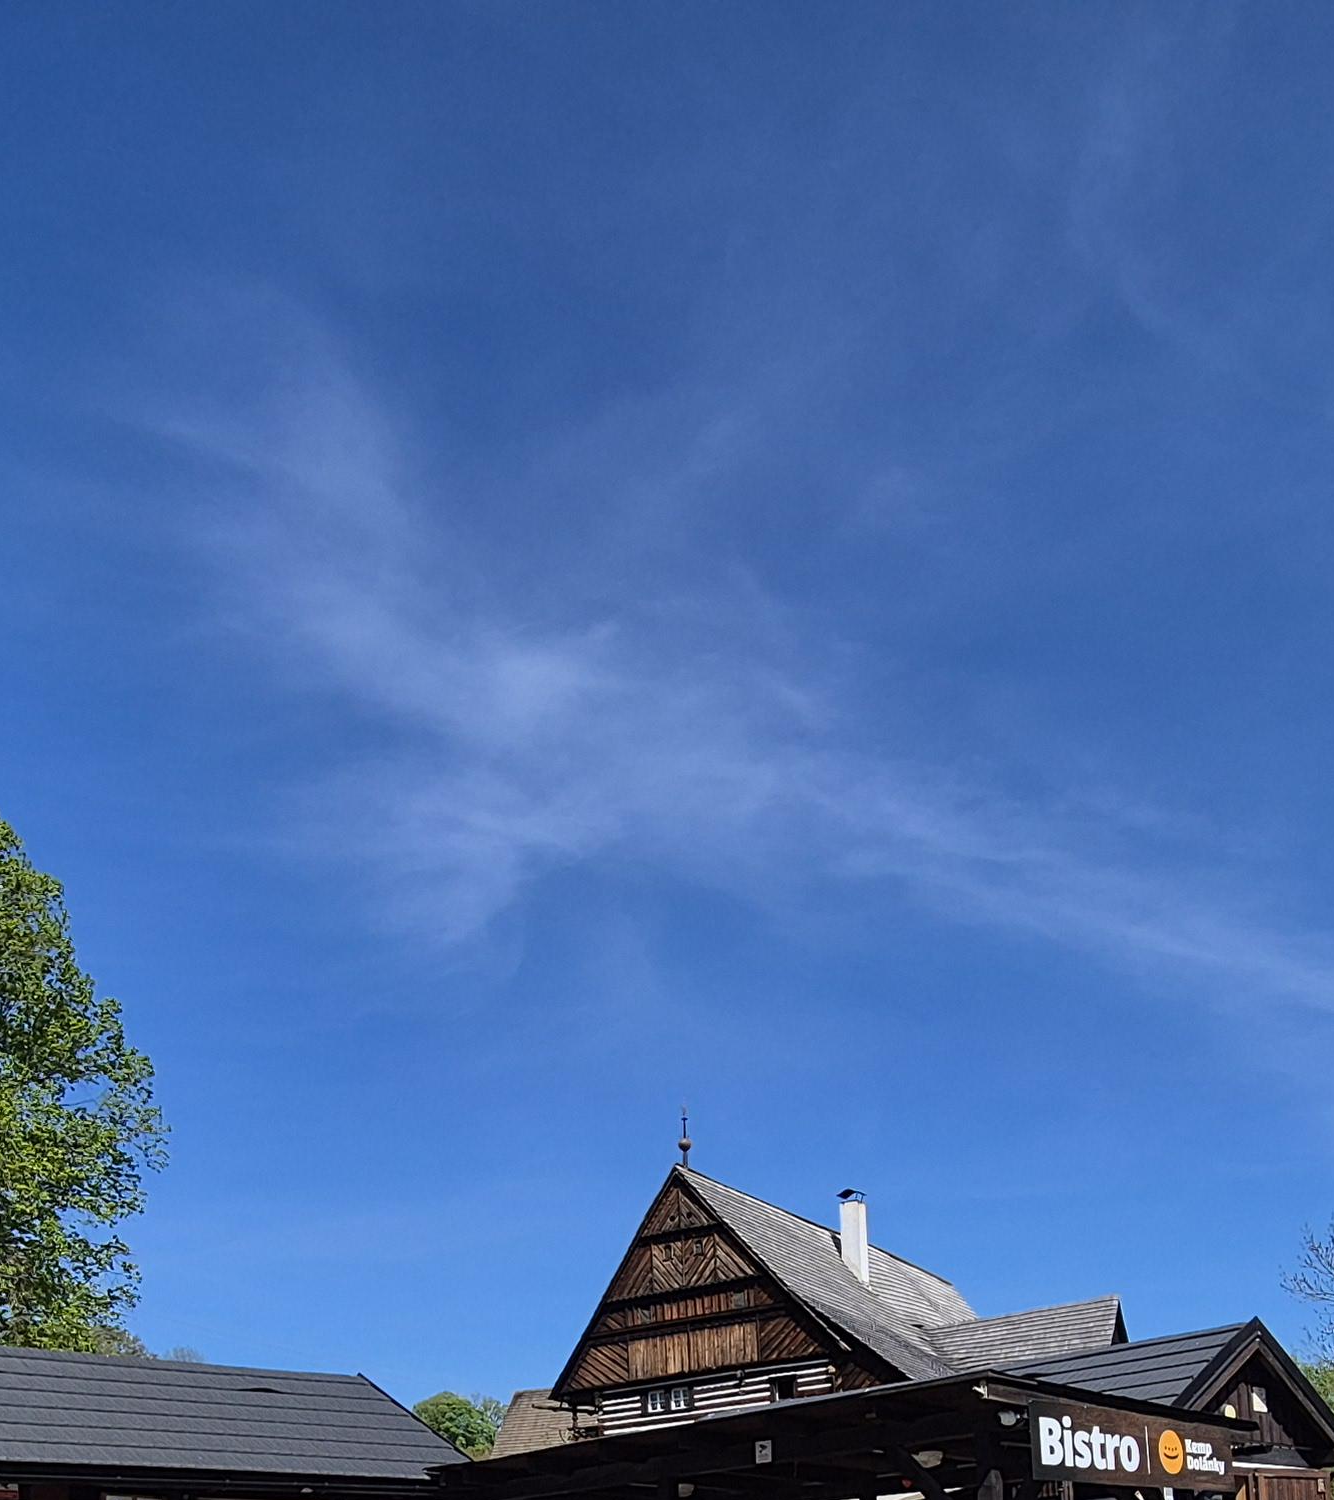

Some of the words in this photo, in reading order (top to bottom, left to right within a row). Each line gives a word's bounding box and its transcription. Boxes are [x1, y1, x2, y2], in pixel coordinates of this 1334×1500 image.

[1038, 1416, 1140, 1473] Bistro
[1184, 1438, 1213, 1459] Kemp
[1186, 1455, 1226, 1476] Dolánky
